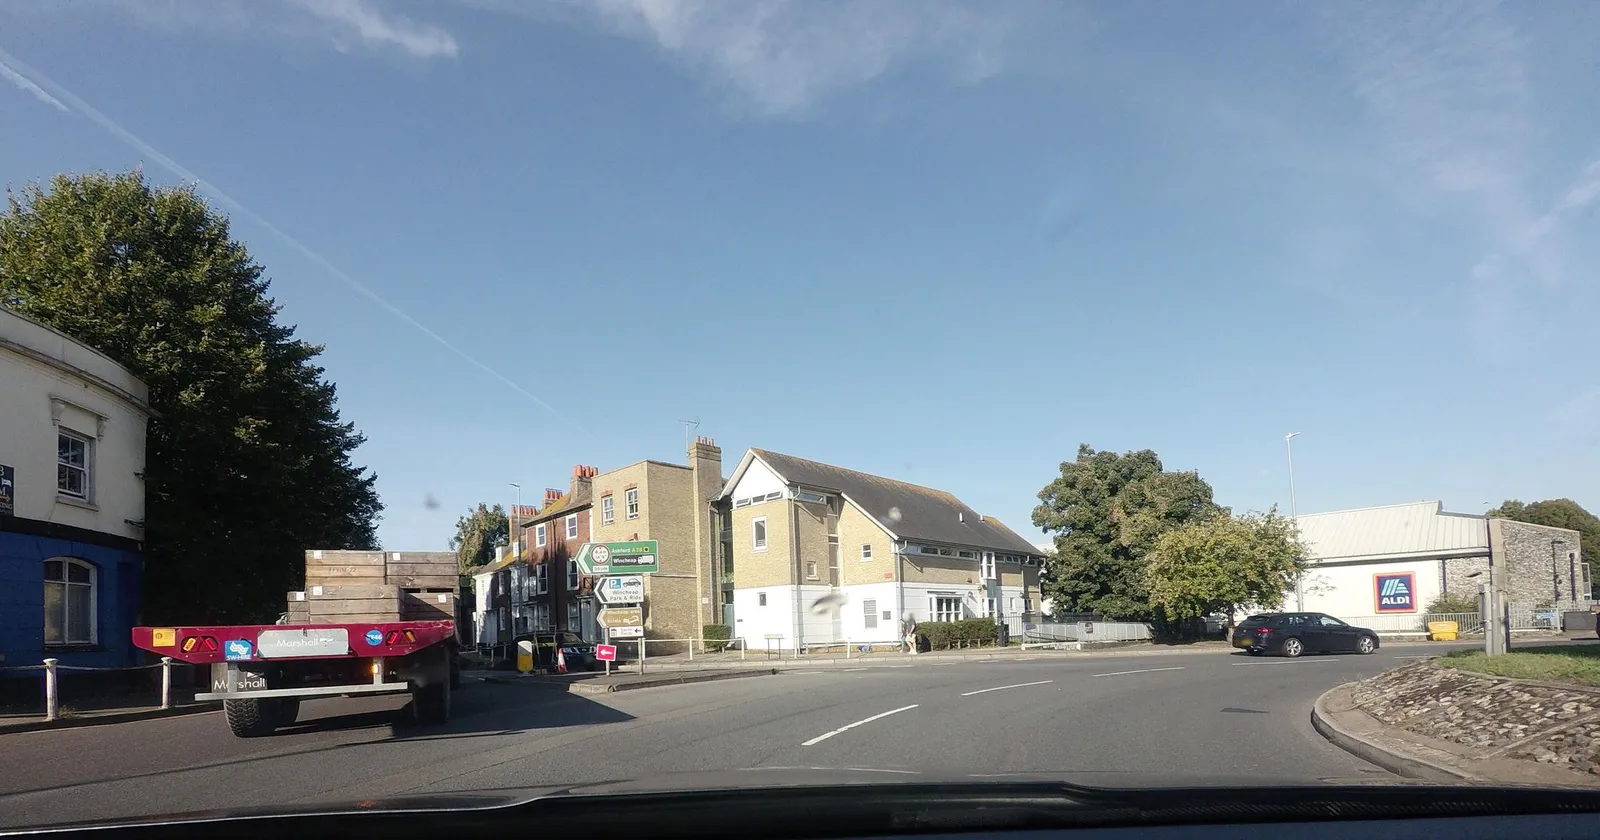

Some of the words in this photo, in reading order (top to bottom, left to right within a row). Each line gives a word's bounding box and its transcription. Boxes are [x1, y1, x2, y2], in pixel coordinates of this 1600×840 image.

[1381, 596, 1410, 605] ALDI
[276, 638, 319, 648] Marshall
[213, 678, 266, 690] Mshall
